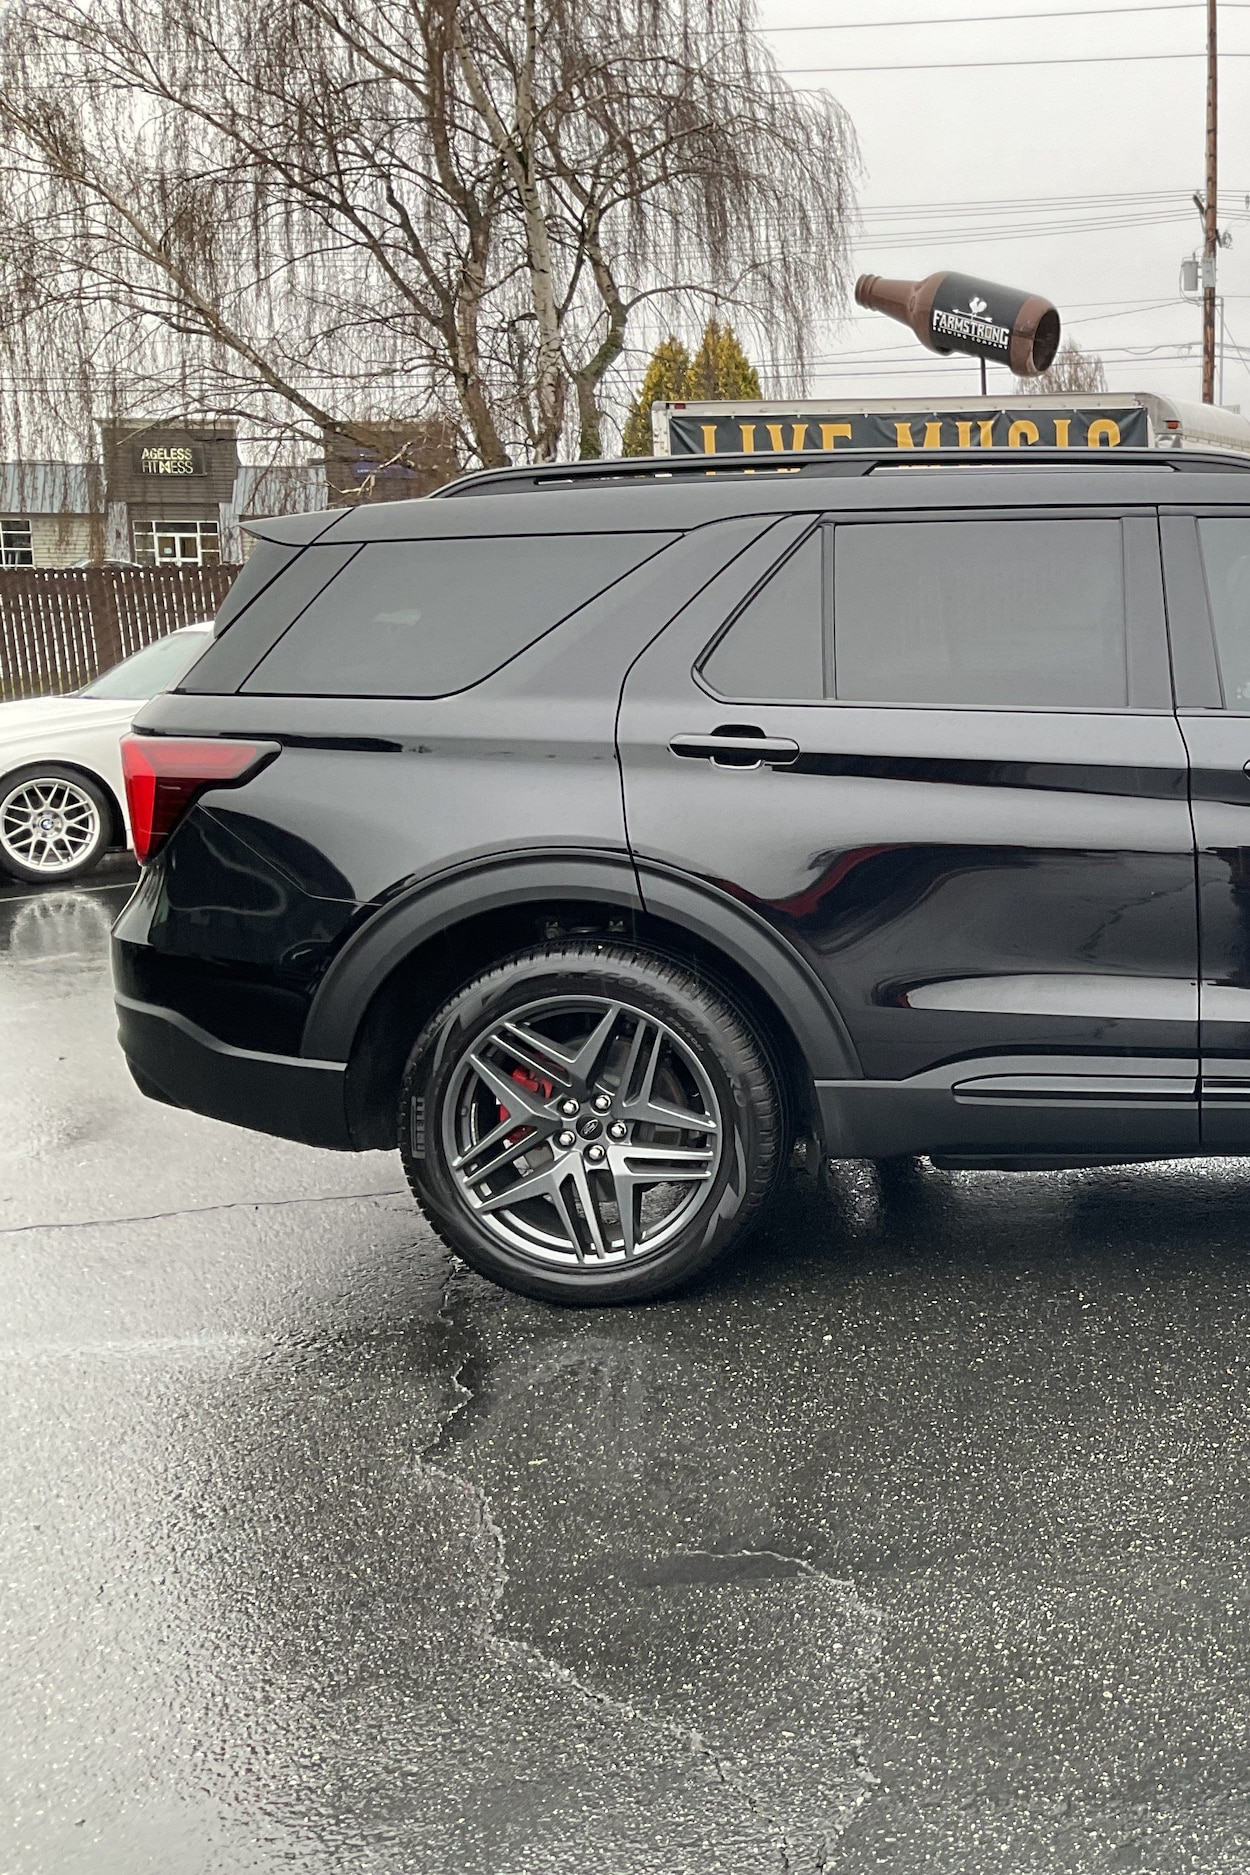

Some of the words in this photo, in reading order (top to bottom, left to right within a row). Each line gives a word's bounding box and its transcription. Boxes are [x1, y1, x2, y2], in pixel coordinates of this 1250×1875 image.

[933, 309, 1010, 346] FARMSTRONG
[141, 447, 193, 460] AGELESS
[142, 460, 194, 474] FITNESS
